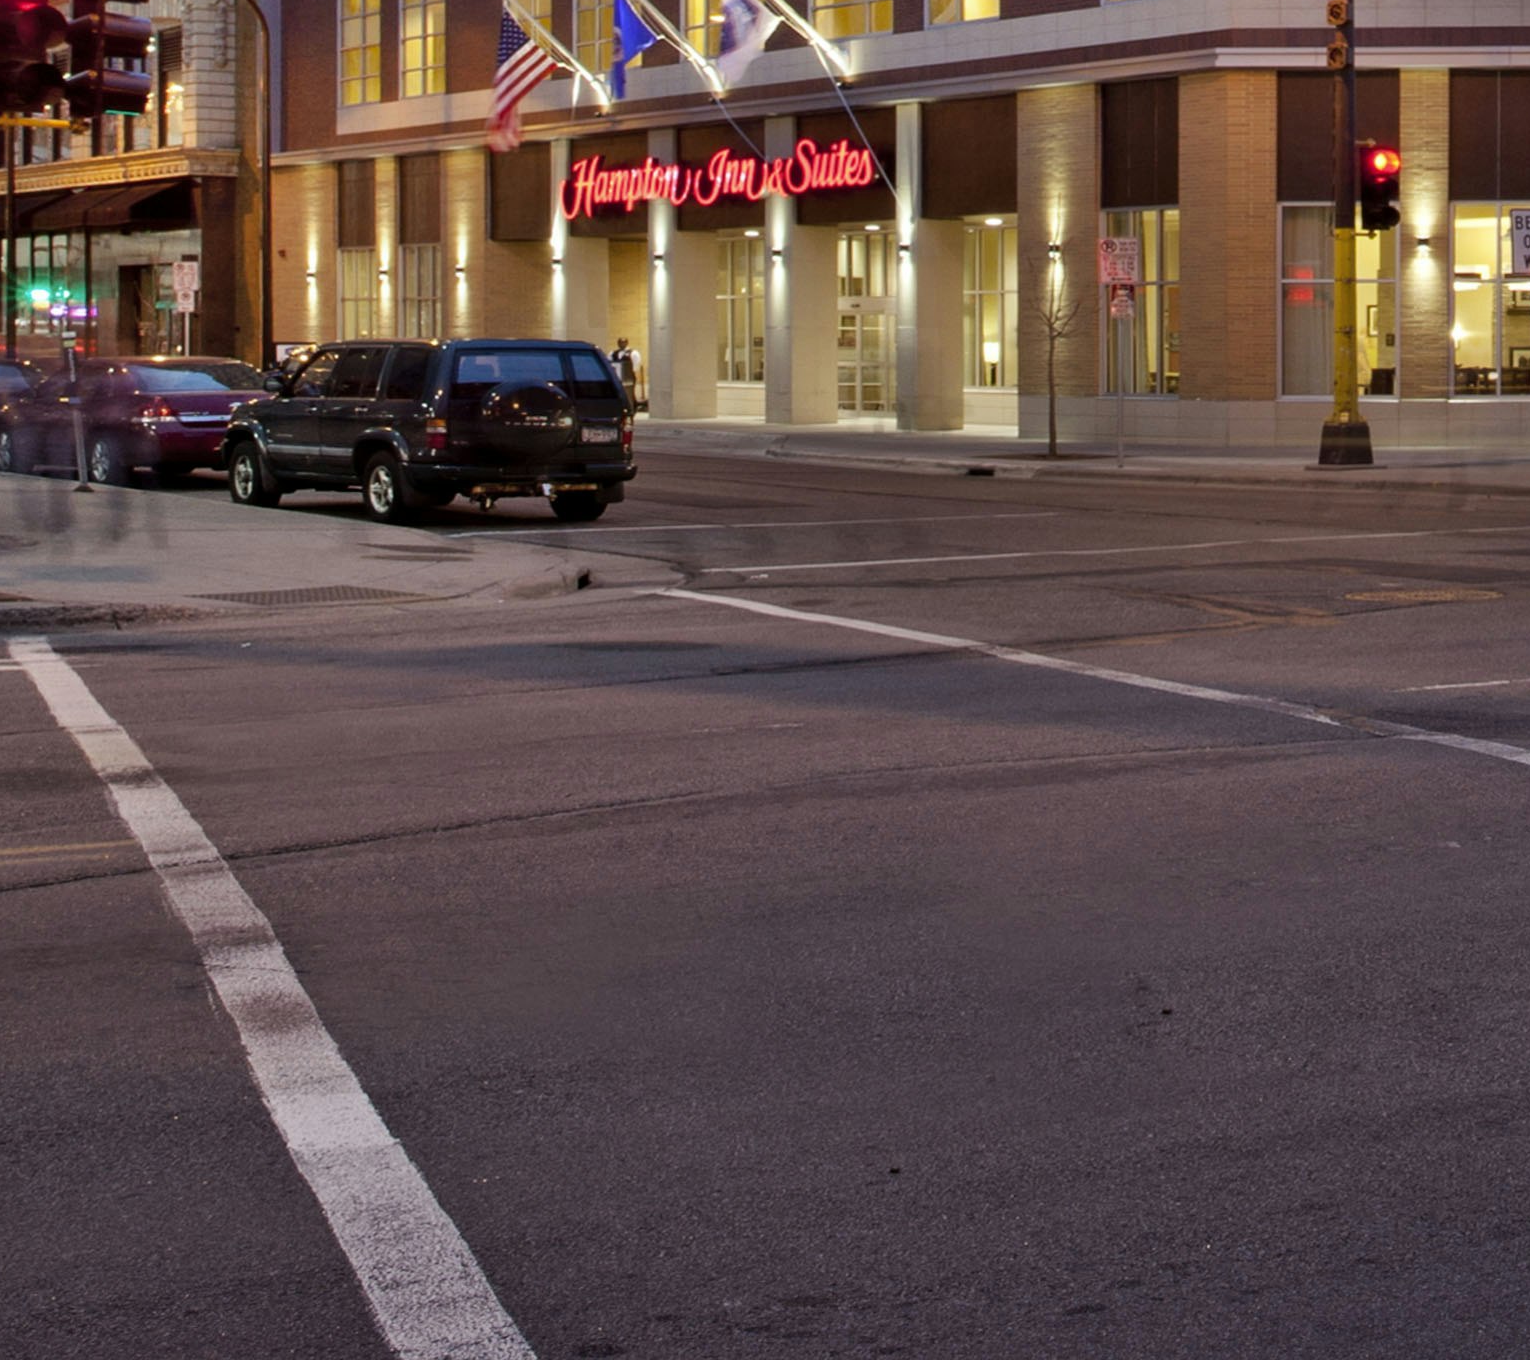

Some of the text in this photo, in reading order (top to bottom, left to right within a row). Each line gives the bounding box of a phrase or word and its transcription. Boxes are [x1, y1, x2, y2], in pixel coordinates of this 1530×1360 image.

[559, 138, 872, 219] Hampton Inn & Suites
